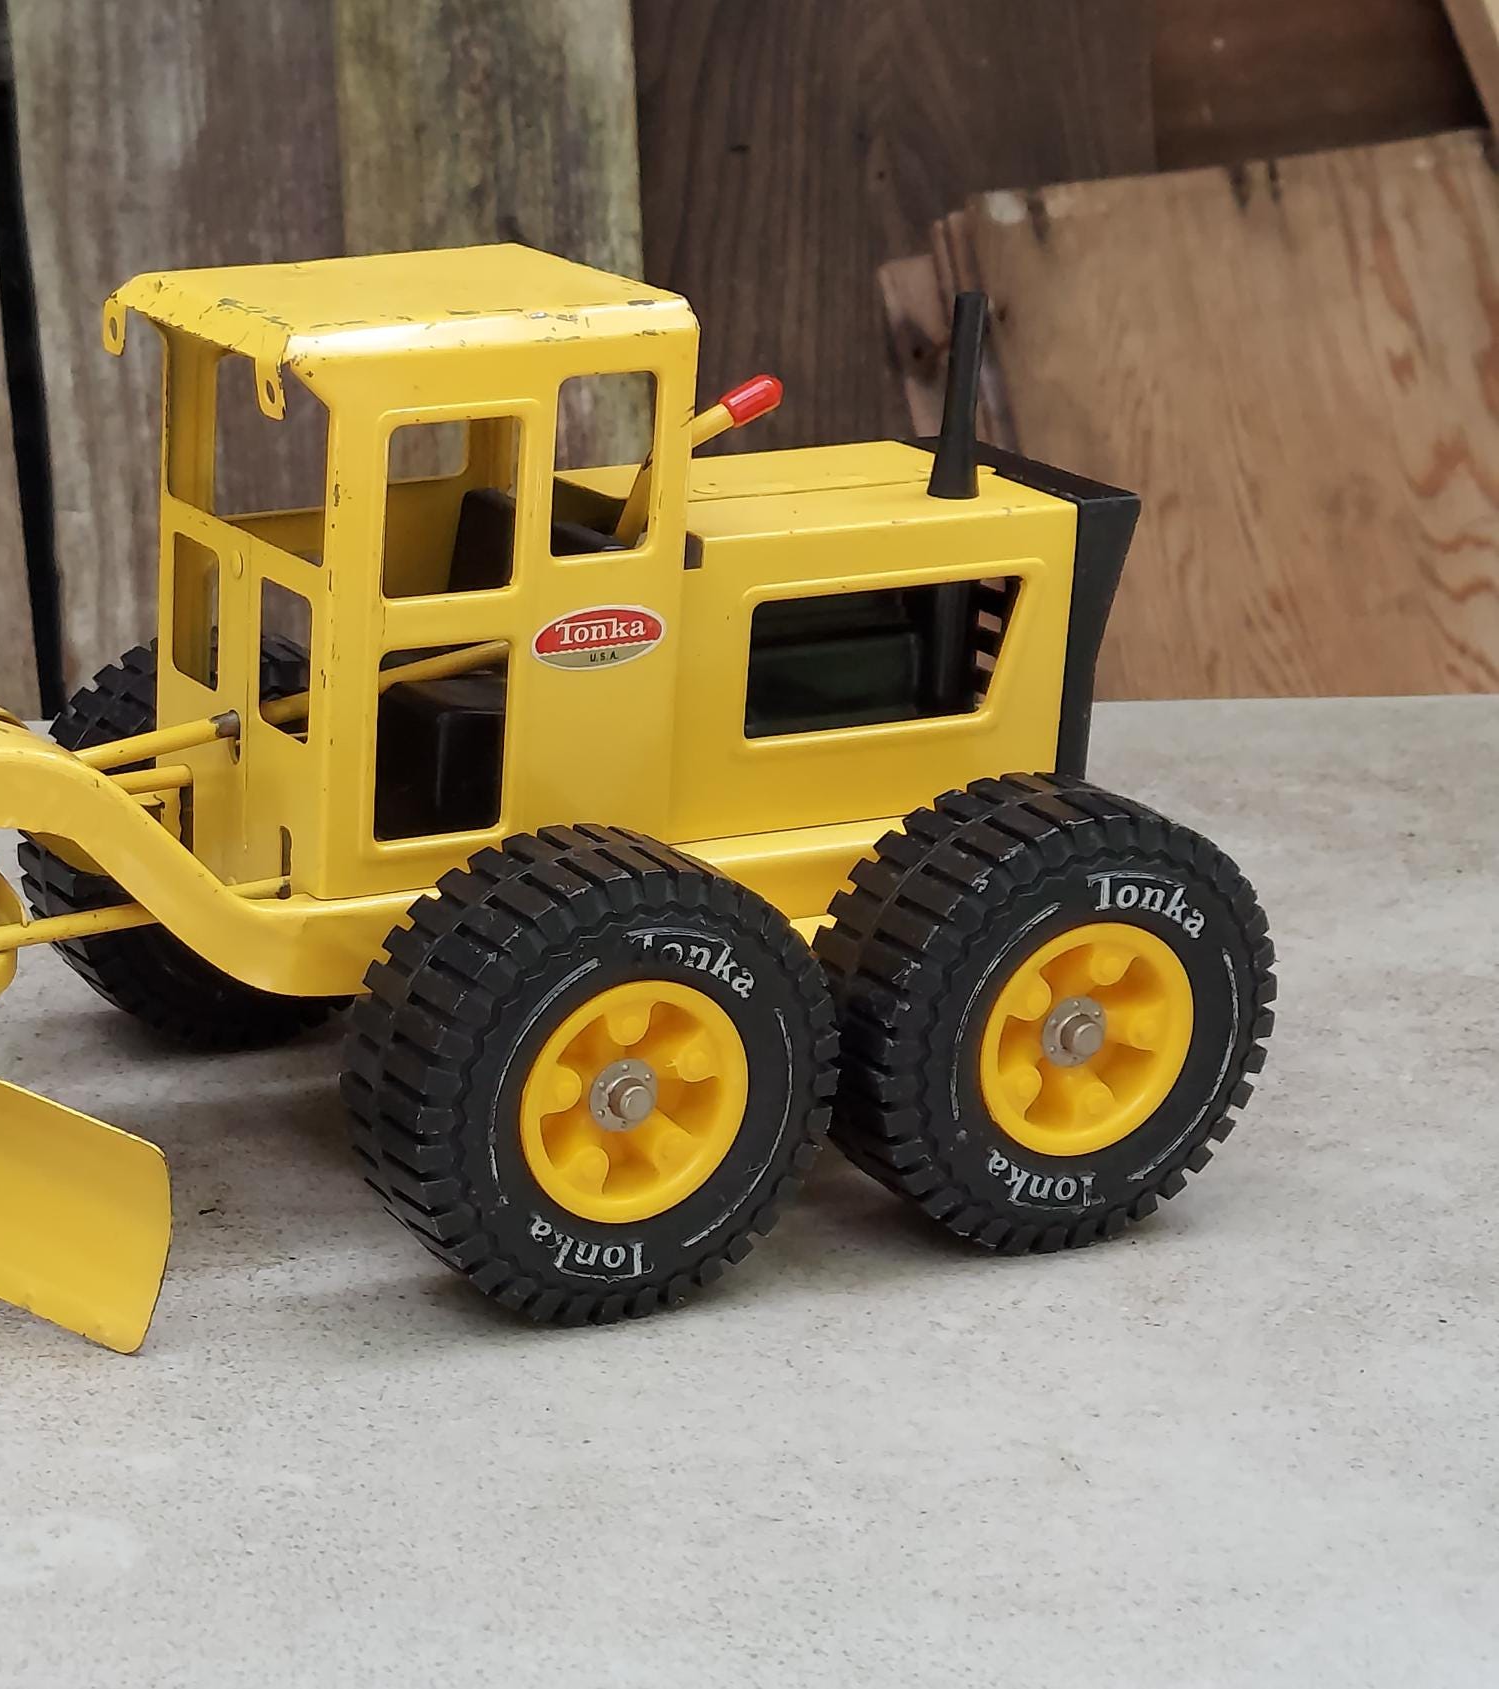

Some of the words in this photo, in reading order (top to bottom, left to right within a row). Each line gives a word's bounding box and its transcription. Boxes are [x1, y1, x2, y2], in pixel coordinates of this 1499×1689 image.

[555, 617, 647, 645] Tonka
[1086, 870, 1206, 939] Tonka
[987, 1148, 1106, 1215] Tonka
[529, 1213, 655, 1284] Tonka
